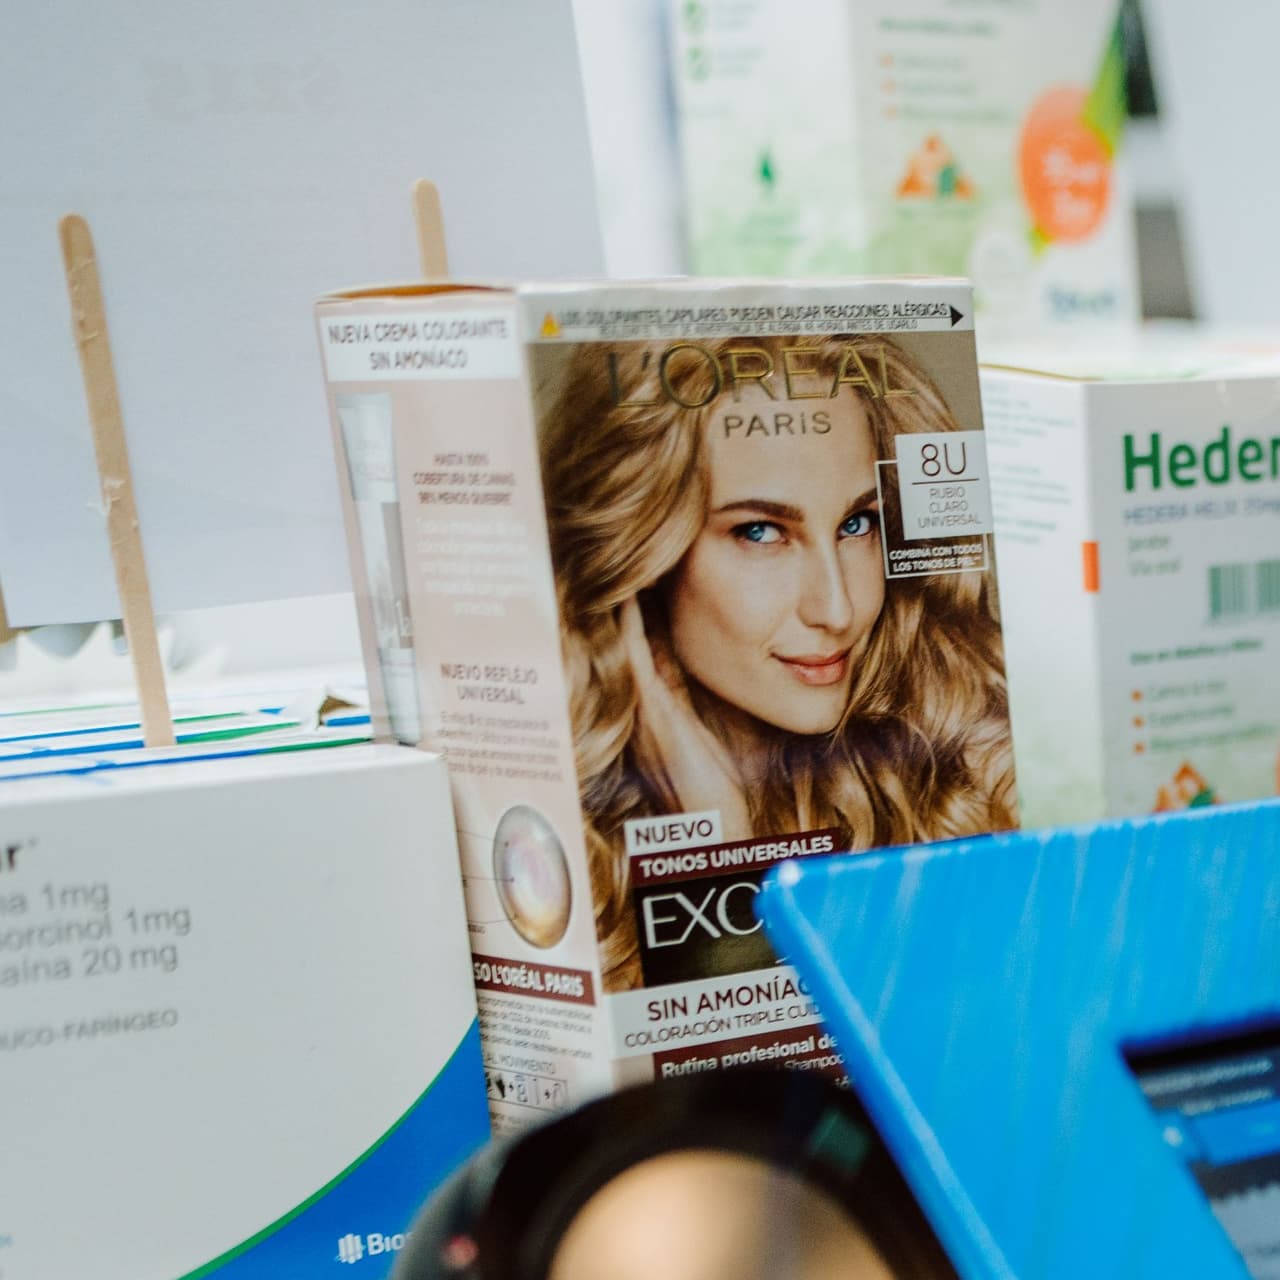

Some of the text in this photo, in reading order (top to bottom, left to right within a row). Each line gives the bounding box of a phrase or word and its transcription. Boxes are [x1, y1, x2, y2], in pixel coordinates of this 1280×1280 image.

[328, 317, 509, 343] NUEVA CREMA COLORANTE
[921, 441, 967, 477] 8U
[928, 501, 969, 514] CLARO
[929, 486, 966, 499] RUBIO
[917, 513, 983, 529] UNIVERSAL
[439, 662, 539, 685] NUEVO REFLEJO
[457, 685, 526, 705] UNIVERSAL
[634, 819, 713, 847] NUEVO
[639, 835, 834, 879] TONOS UNIVERSALES
[642, 880, 774, 949] EXC
[0, 911, 113, 952] orcinol
[491, 964, 545, 991] L'ORÉAL
[544, 971, 585, 997] PARIS
[646, 975, 812, 1022] SIN AMONÍAC
[624, 1003, 822, 1048] COLORACIÓN TRIPLE CUID
[661, 1033, 839, 1079] Rutina profesional de
